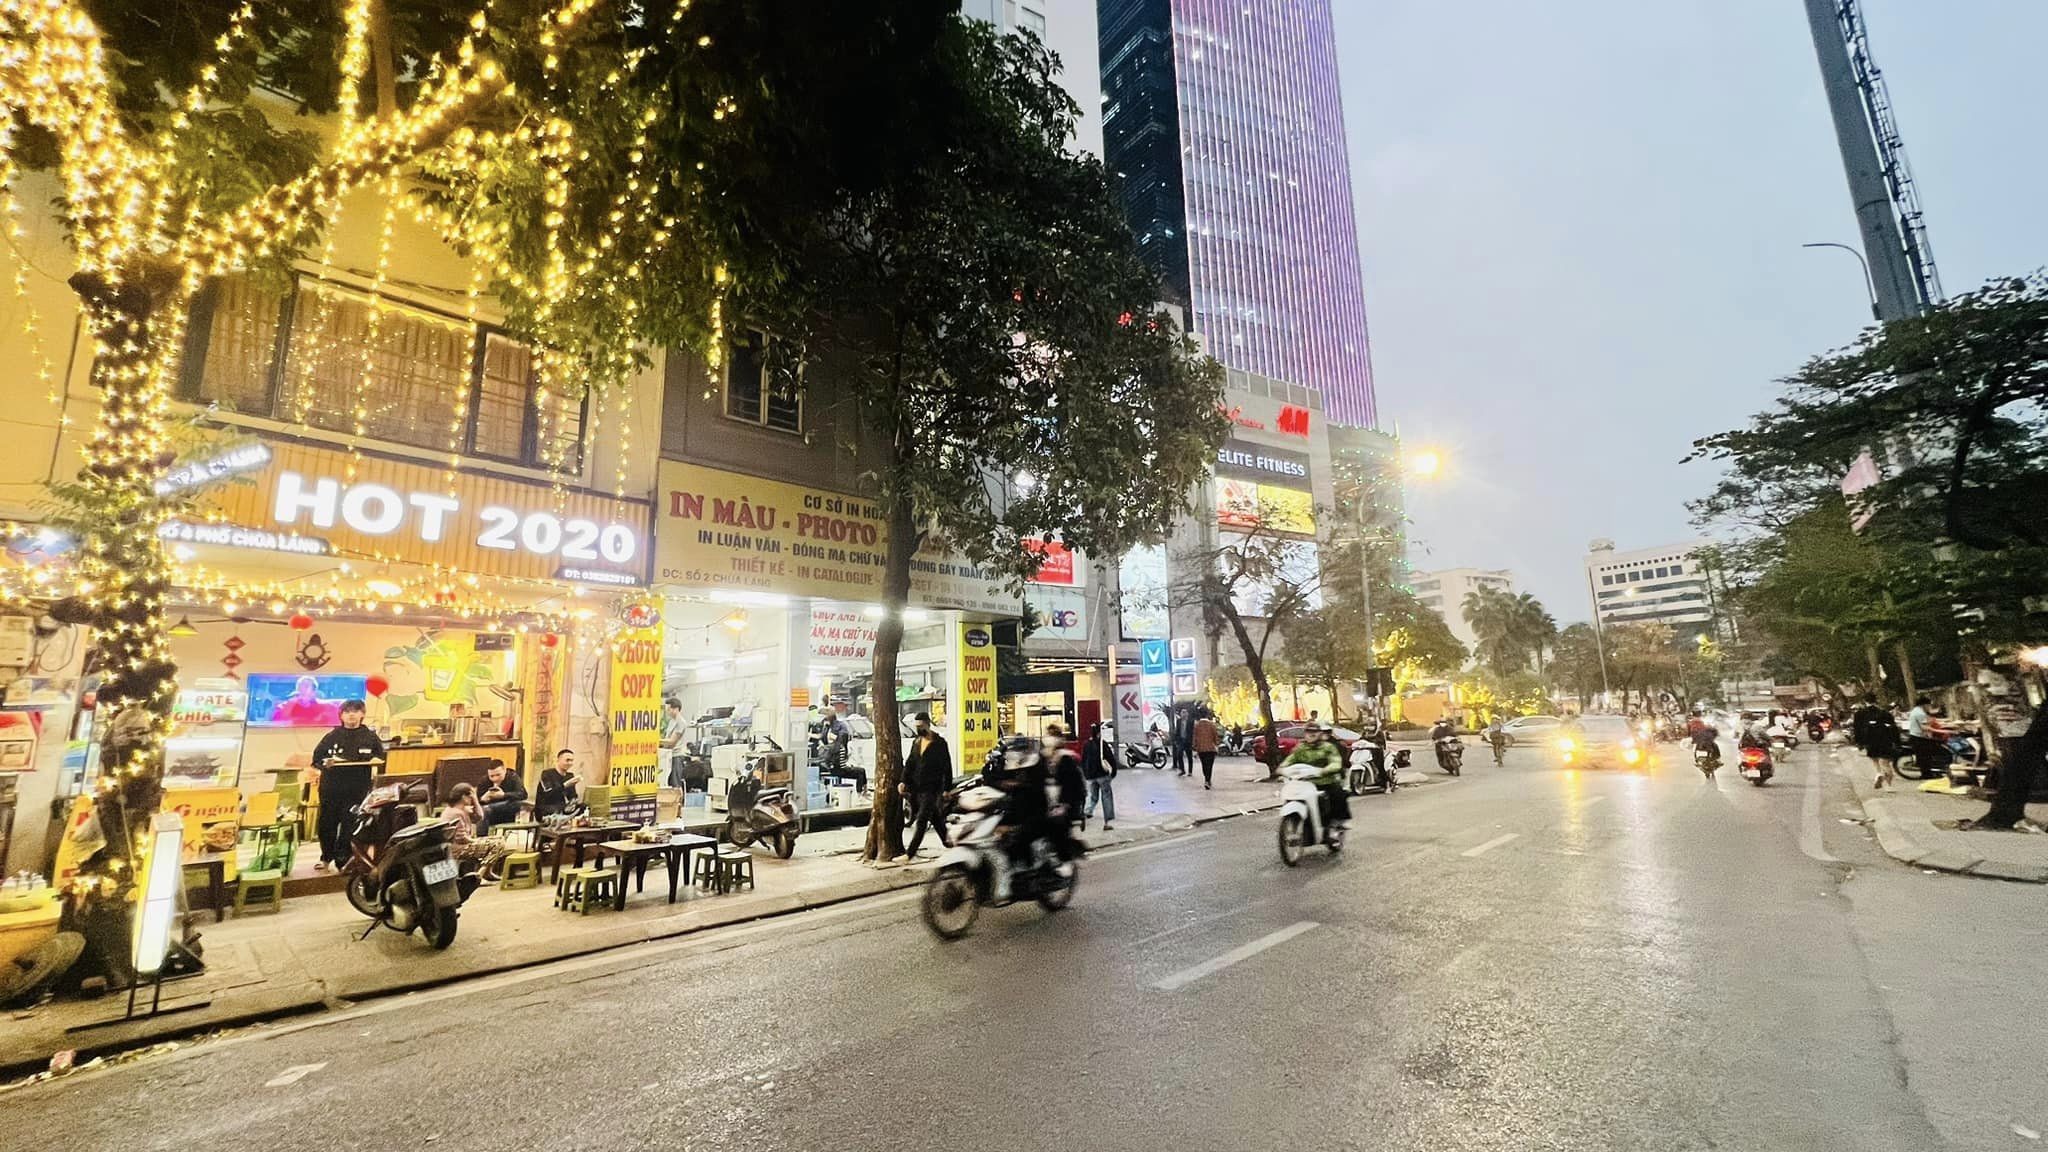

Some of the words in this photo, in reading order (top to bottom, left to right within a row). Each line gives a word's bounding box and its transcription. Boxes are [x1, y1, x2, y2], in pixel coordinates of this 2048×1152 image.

[1217, 448, 1253, 467] ELITE
[1256, 456, 1305, 477] FITNESS
[803, 494, 822, 510] CƠ
[825, 494, 844, 514] SỞ
[845, 502, 860, 517] IN
[274, 471, 459, 543] HOT
[476, 506, 636, 564] 2020
[669, 490, 704, 521] IN
[711, 495, 776, 532] MÀU
[796, 512, 878, 546] PHOTO
[698, 529, 713, 545] IN
[717, 532, 752, 552] LUẬN
[755, 537, 781, 554] VĂN
[792, 542, 825, 560] ĐÓNG
[828, 549, 846, 563] MẠ
[703, 572, 710, 582] 2
[731, 555, 765, 574] THIẾT
[797, 565, 809, 579] IN
[813, 568, 873, 586] CATALOGUE
[964, 655, 991, 672] PHOTO
[620, 673, 654, 700] COPY
[967, 678, 989, 695] COPY
[965, 699, 973, 714] IN
[614, 711, 627, 732] IN
[623, 764, 656, 786] PLASTIC
